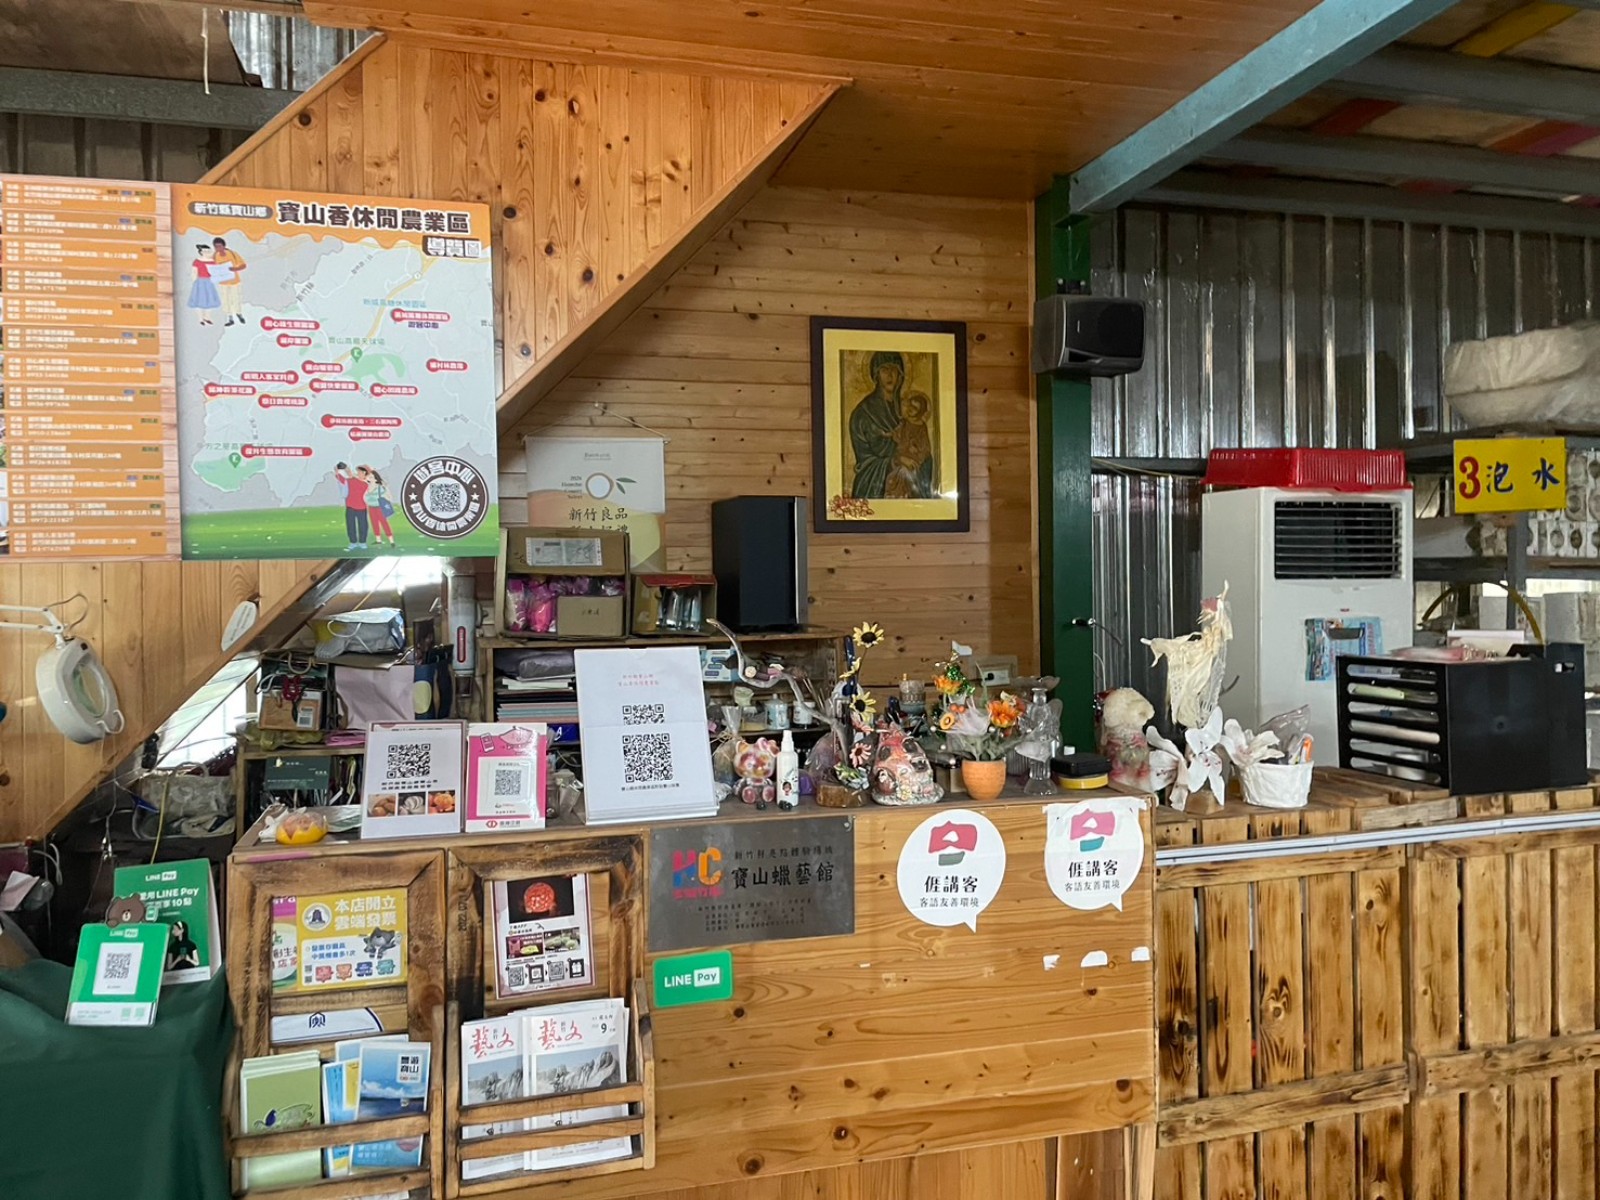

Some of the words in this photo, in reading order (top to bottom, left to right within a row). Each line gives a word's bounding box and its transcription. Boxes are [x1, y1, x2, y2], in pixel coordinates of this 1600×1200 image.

[193, 202, 267, 218] 新竹縣寶山鄉
[277, 201, 471, 234] 寶山香休閒農業區
[568, 506, 628, 521] 新竹良品
[731, 862, 835, 889] 寶山蠟藝館
[180, 887, 199, 897] Pay
[1064, 881, 1121, 893] 客語友善環境
[334, 895, 397, 913] 本店開立
[919, 897, 980, 908] 客語友善環境
[334, 911, 397, 931] 雲端發票
[664, 974, 692, 988] LINE
[697, 972, 717, 982] Pay
[600, 1022, 608, 1034] 9
